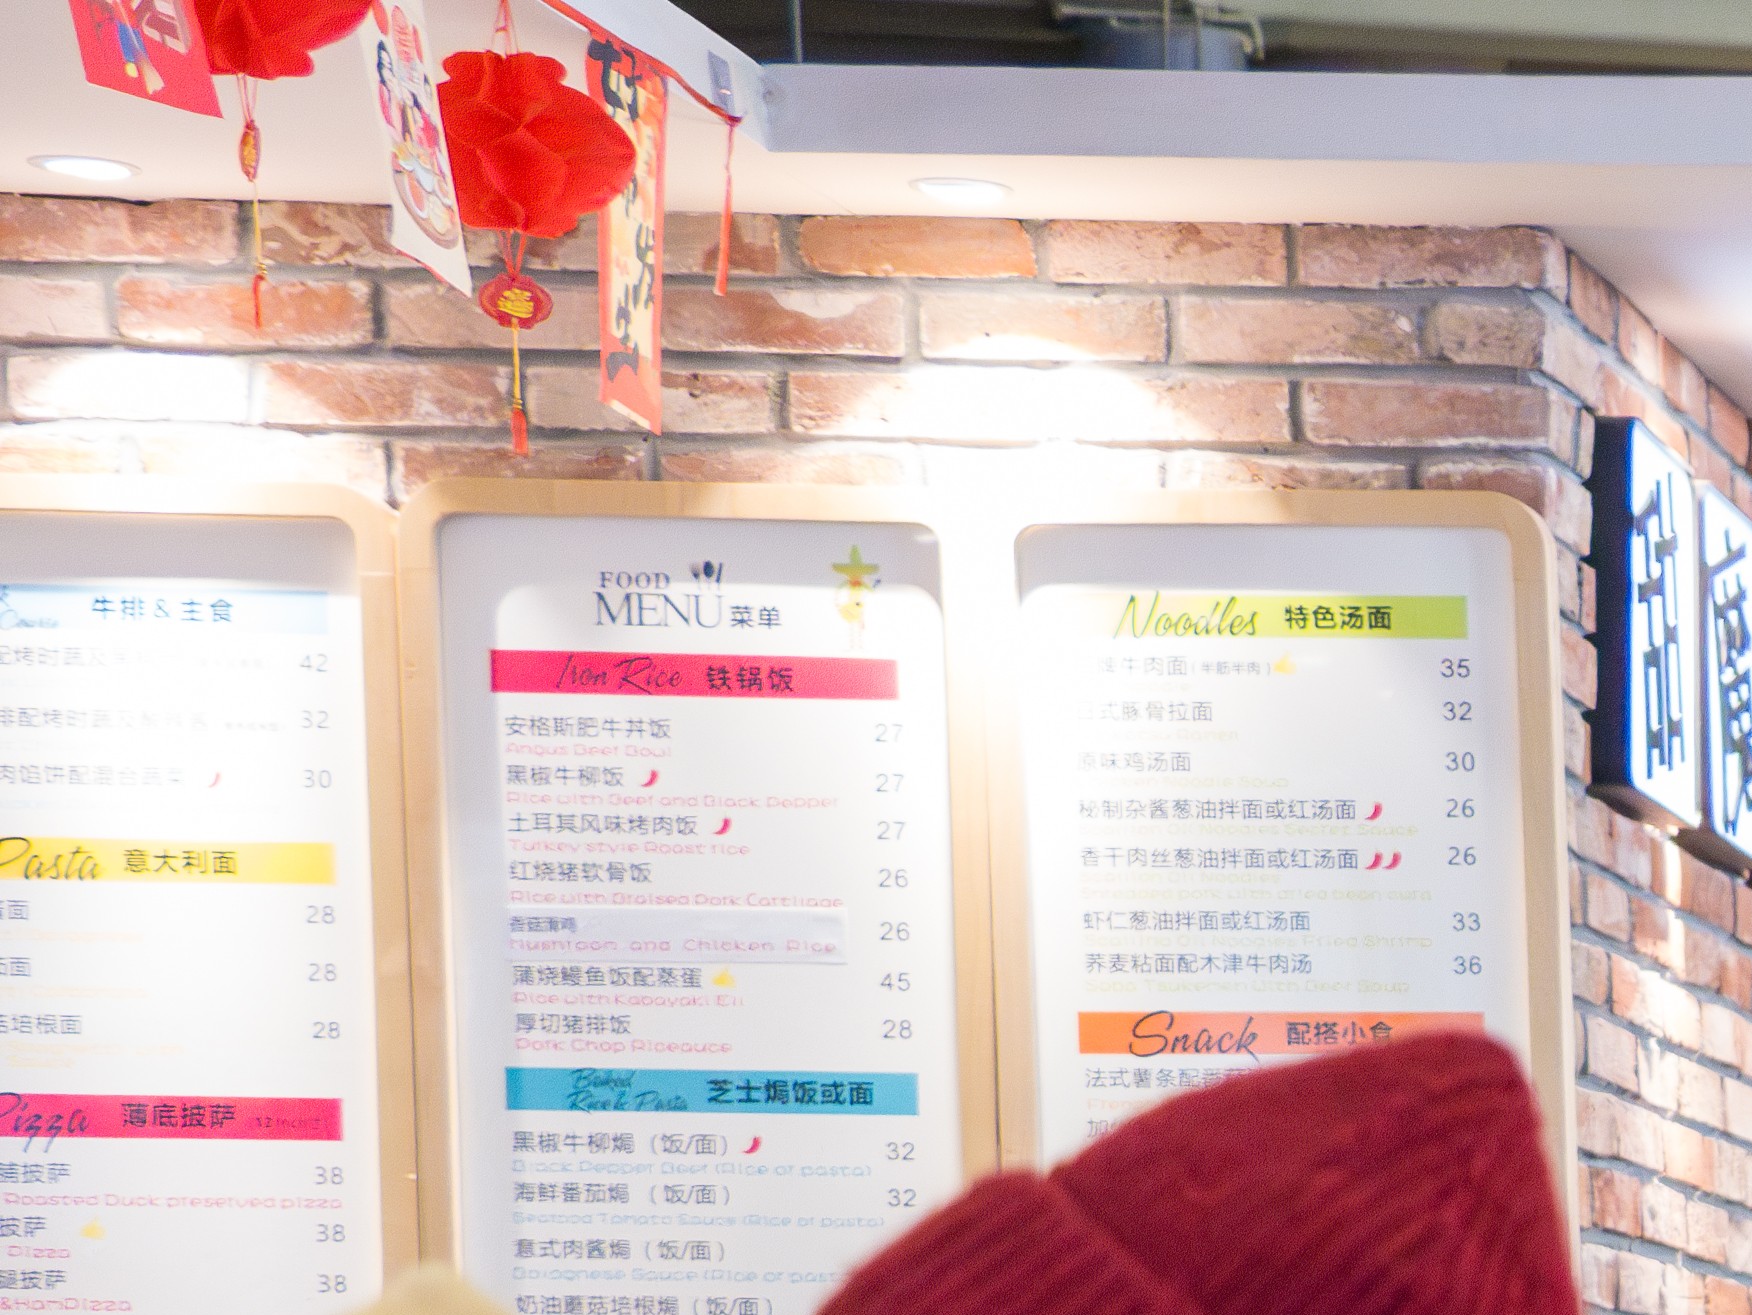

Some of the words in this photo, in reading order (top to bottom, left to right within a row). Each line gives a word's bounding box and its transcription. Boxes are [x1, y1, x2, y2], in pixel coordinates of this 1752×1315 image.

[599, 571, 671, 589] FOOD
[593, 591, 721, 629] MENU
[730, 605, 782, 629] 菜单
[1113, 592, 1260, 640] Noodles
[1284, 606, 1393, 631] 特色汤面
[299, 654, 328, 672] 42
[1440, 659, 1471, 678] 35
[614, 658, 683, 694] Rice
[707, 666, 794, 692] 铁锅饭
[300, 711, 330, 729] 32
[1442, 703, 1472, 721] 32
[504, 716, 672, 739] 安格斯肥牛丼饭
[876, 724, 903, 743] 27
[1078, 752, 1191, 772] 原味鸡汤面
[1445, 752, 1475, 771] 30
[304, 770, 332, 789] 30
[506, 765, 624, 787] 黑椒牛柳饭
[876, 774, 904, 793] 27
[1079, 799, 1356, 820] 秘制杂酱葱油拌面或红汤面
[1446, 799, 1475, 818] 26
[507, 813, 698, 836] 土耳其风味烤肉饭
[877, 822, 906, 841] 27
[123, 850, 238, 874] 意大利面
[1081, 848, 1358, 870] 香干肉丝葱油拌面或红汤面
[1447, 847, 1476, 865] 26
[509, 862, 652, 883] 红烧猪软骨饭
[879, 868, 908, 889] 26
[306, 905, 335, 925] 28
[1084, 910, 1310, 931] 虾仁葱油拌面或红汤面
[1452, 913, 1481, 932] 33
[879, 922, 909, 940] 26
[309, 963, 337, 982] 28
[1085, 954, 1313, 975] 荞麦粘面配木津牛肉汤
[1454, 956, 1482, 975] 36
[513, 966, 702, 988] 蒲烧鳗鱼饭配蒸蛋
[880, 973, 910, 991] 45
[313, 1022, 340, 1039] 28
[515, 1013, 632, 1035] 厚切猪排饭
[882, 1019, 912, 1039] 28
[1128, 1009, 1259, 1062] Snack
[708, 1080, 874, 1106] 芝士焗饭或面
[122, 1103, 235, 1128] 薄底披萨
[887, 1142, 915, 1161] 32
[314, 1166, 344, 1184] 38
[888, 1189, 916, 1207] 32
[316, 1224, 345, 1242] 38
[317, 1274, 347, 1292] 38
